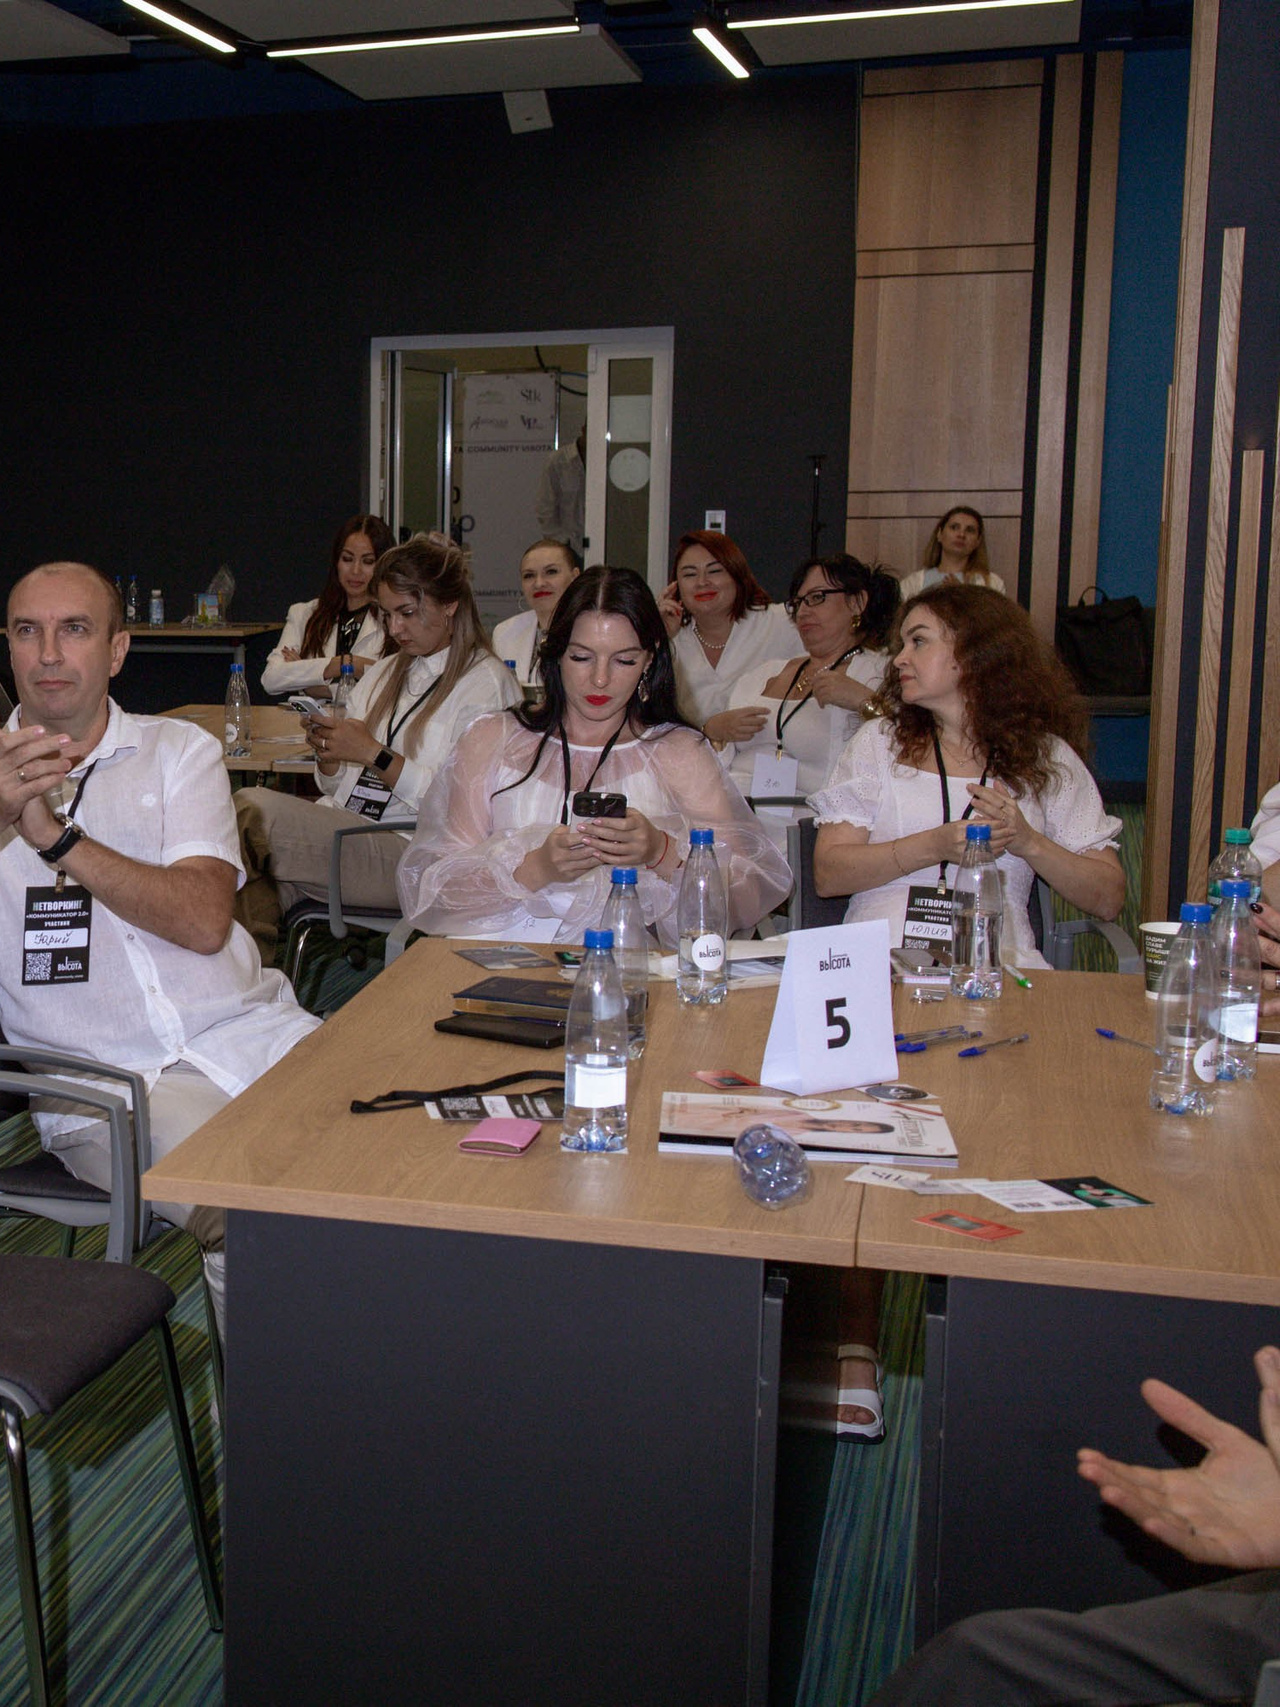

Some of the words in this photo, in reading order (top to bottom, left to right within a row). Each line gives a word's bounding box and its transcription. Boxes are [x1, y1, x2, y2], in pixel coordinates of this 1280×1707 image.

[467, 444, 519, 453] COMMUNITY
[33, 900, 84, 912] НЕТВОРКИНГ
[45, 920, 71, 928] УЧАСТНИК
[699, 944, 722, 958] ВЫСОТА
[57, 956, 83, 972] ВЫСОТА
[819, 947, 851, 971] ВЫСОТА
[825, 997, 851, 1050] 5
